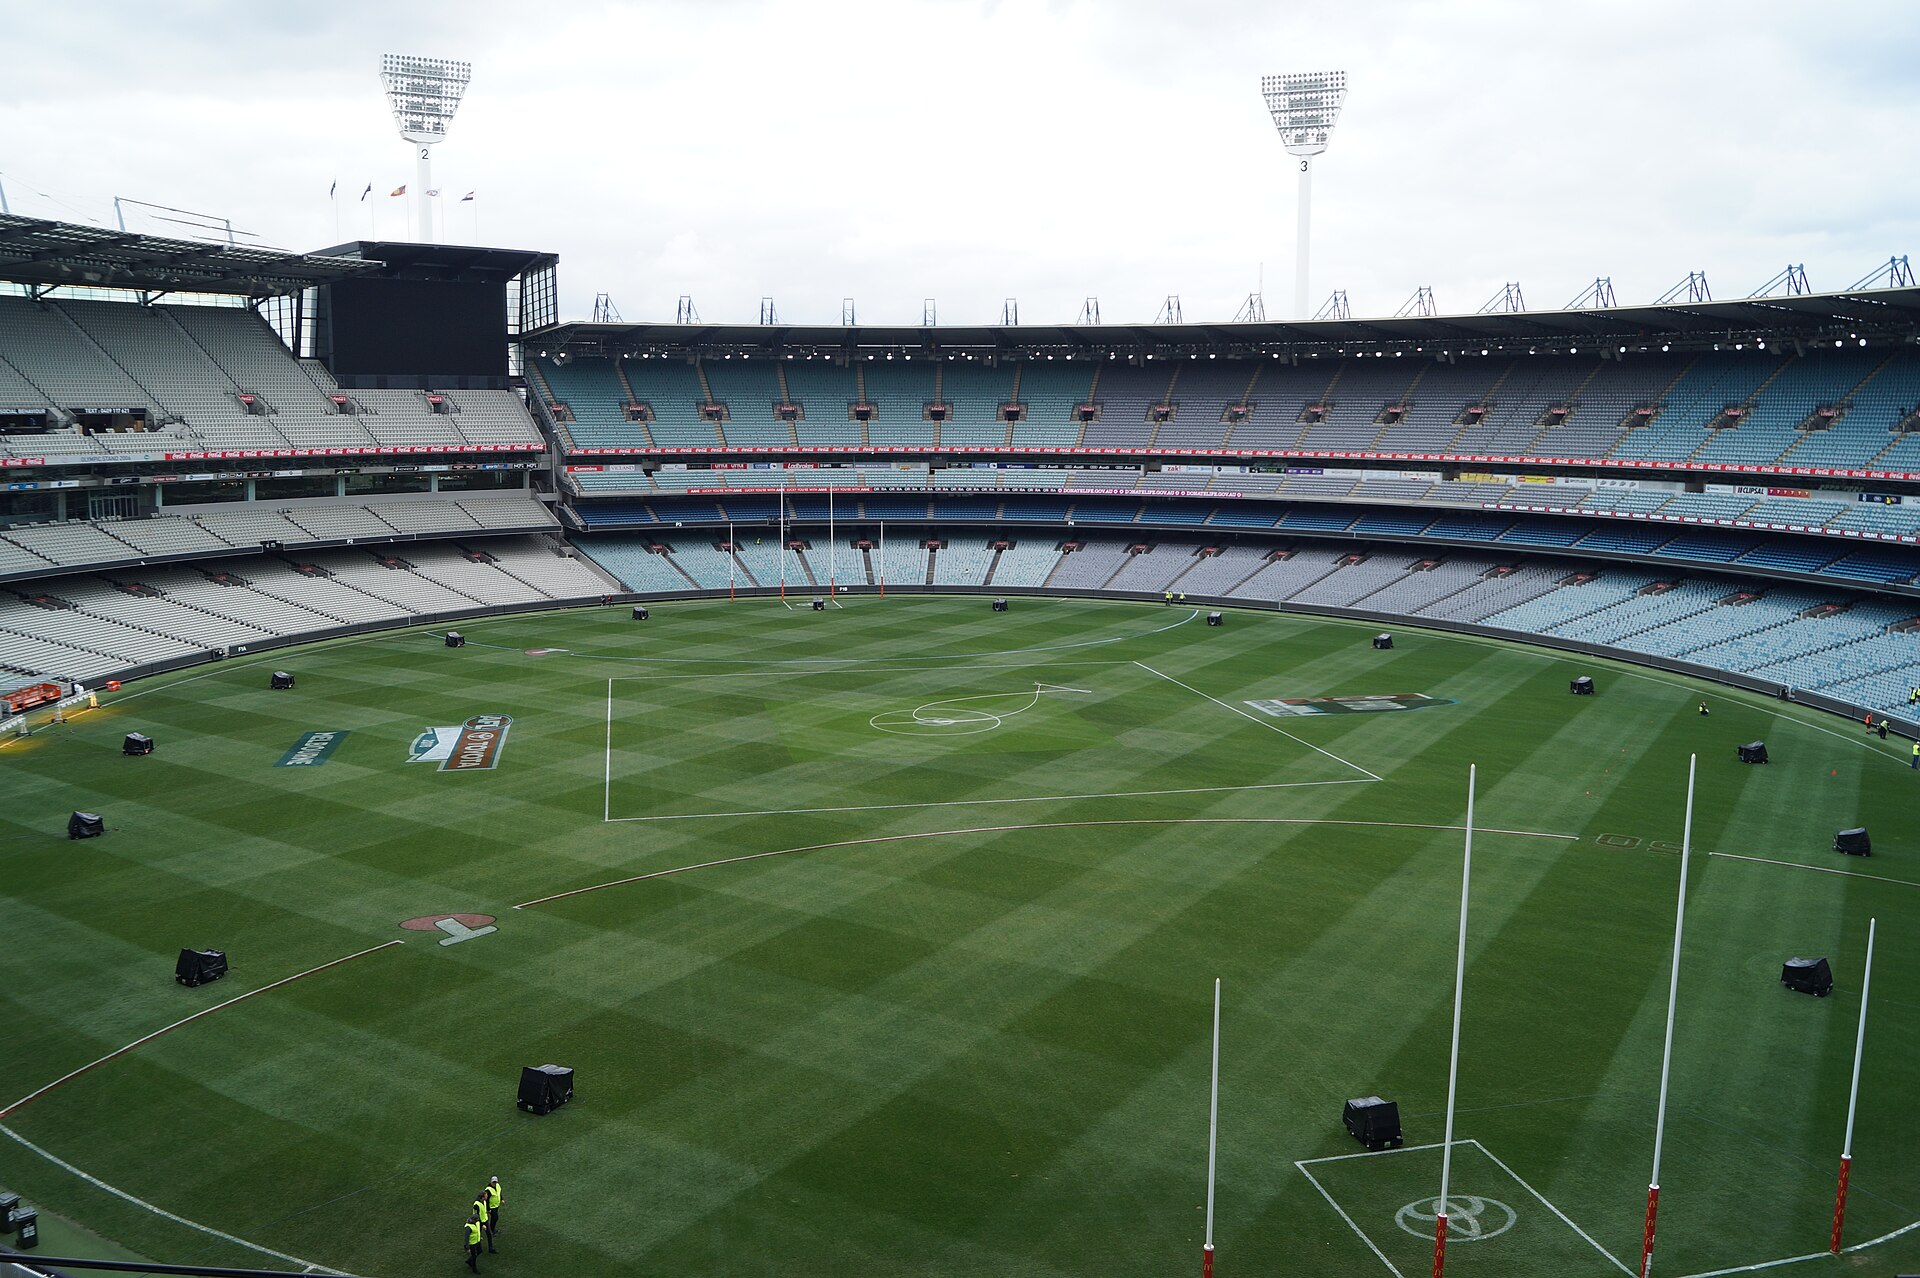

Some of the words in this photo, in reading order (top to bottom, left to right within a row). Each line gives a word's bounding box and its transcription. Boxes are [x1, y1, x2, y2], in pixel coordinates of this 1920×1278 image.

[422, 148, 428, 159] 2
[1300, 160, 1308, 172] 3
[457, 741, 488, 768] TOYOTA
